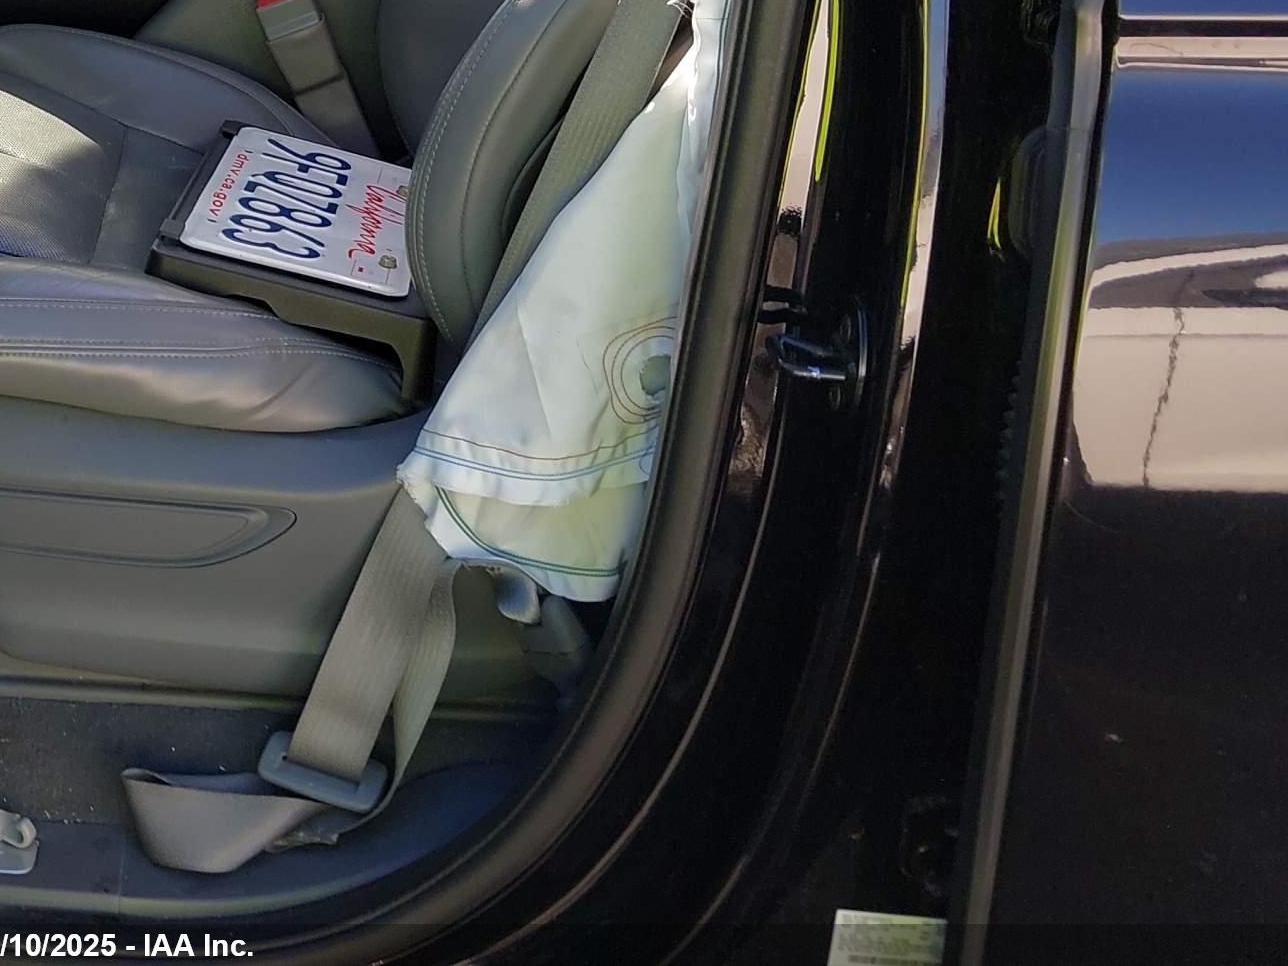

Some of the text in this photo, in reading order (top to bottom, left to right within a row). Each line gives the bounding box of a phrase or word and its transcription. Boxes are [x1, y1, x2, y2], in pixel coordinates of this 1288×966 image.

[208, 153, 249, 217] dmv.ca.gov
[221, 138, 352, 259] 9FQZ863
[345, 185, 408, 259] California
